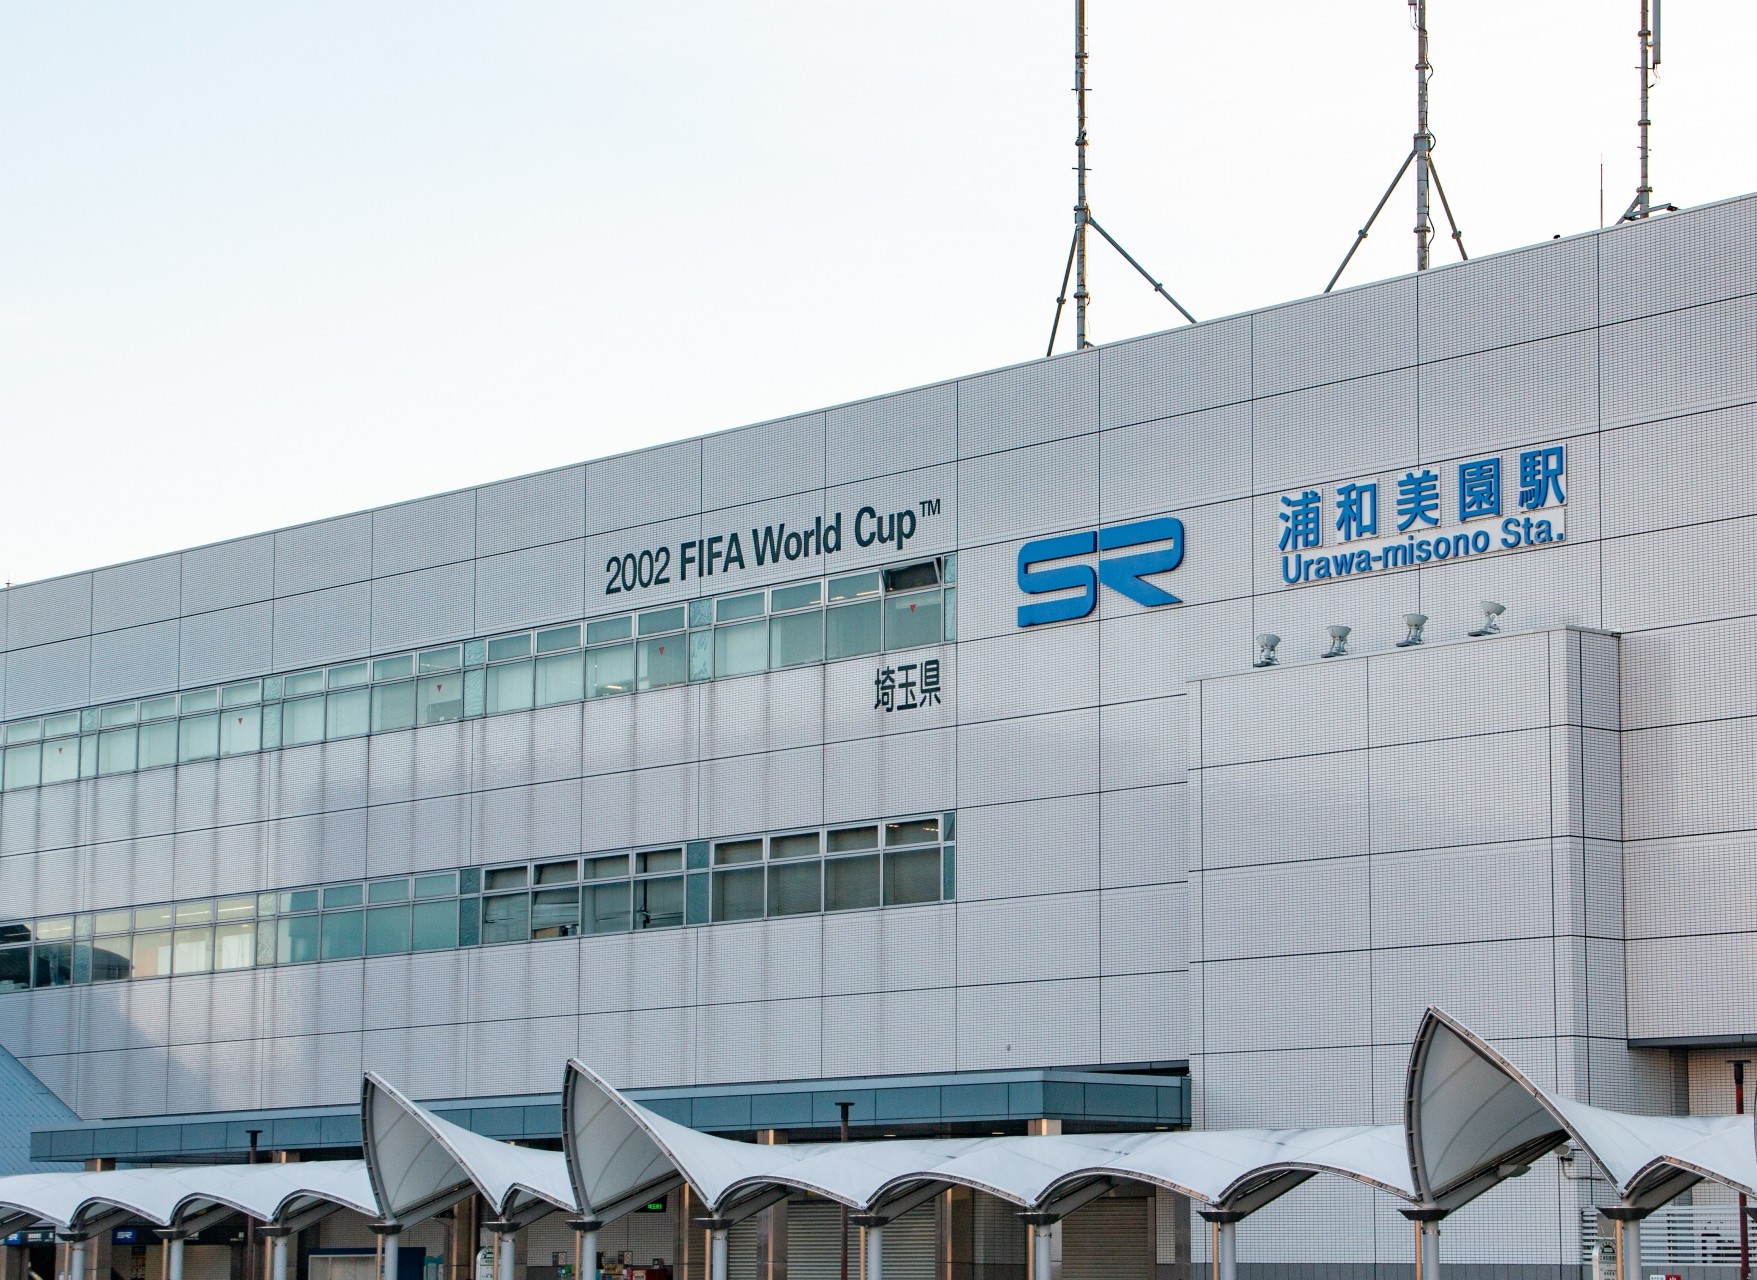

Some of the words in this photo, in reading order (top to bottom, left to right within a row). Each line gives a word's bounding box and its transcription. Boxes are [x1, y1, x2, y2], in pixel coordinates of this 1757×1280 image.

[1278, 444, 1567, 552] 浦和美園駅
[605, 546, 671, 595] 2002
[680, 532, 746, 581] FIFA
[752, 513, 842, 567] World
[1017, 517, 1184, 628] SR
[1281, 531, 1490, 586] Urawa-misono
[1501, 513, 1565, 550] Sta.
[874, 658, 941, 713] 埼玉県
[116, 1231, 133, 1239] SR
